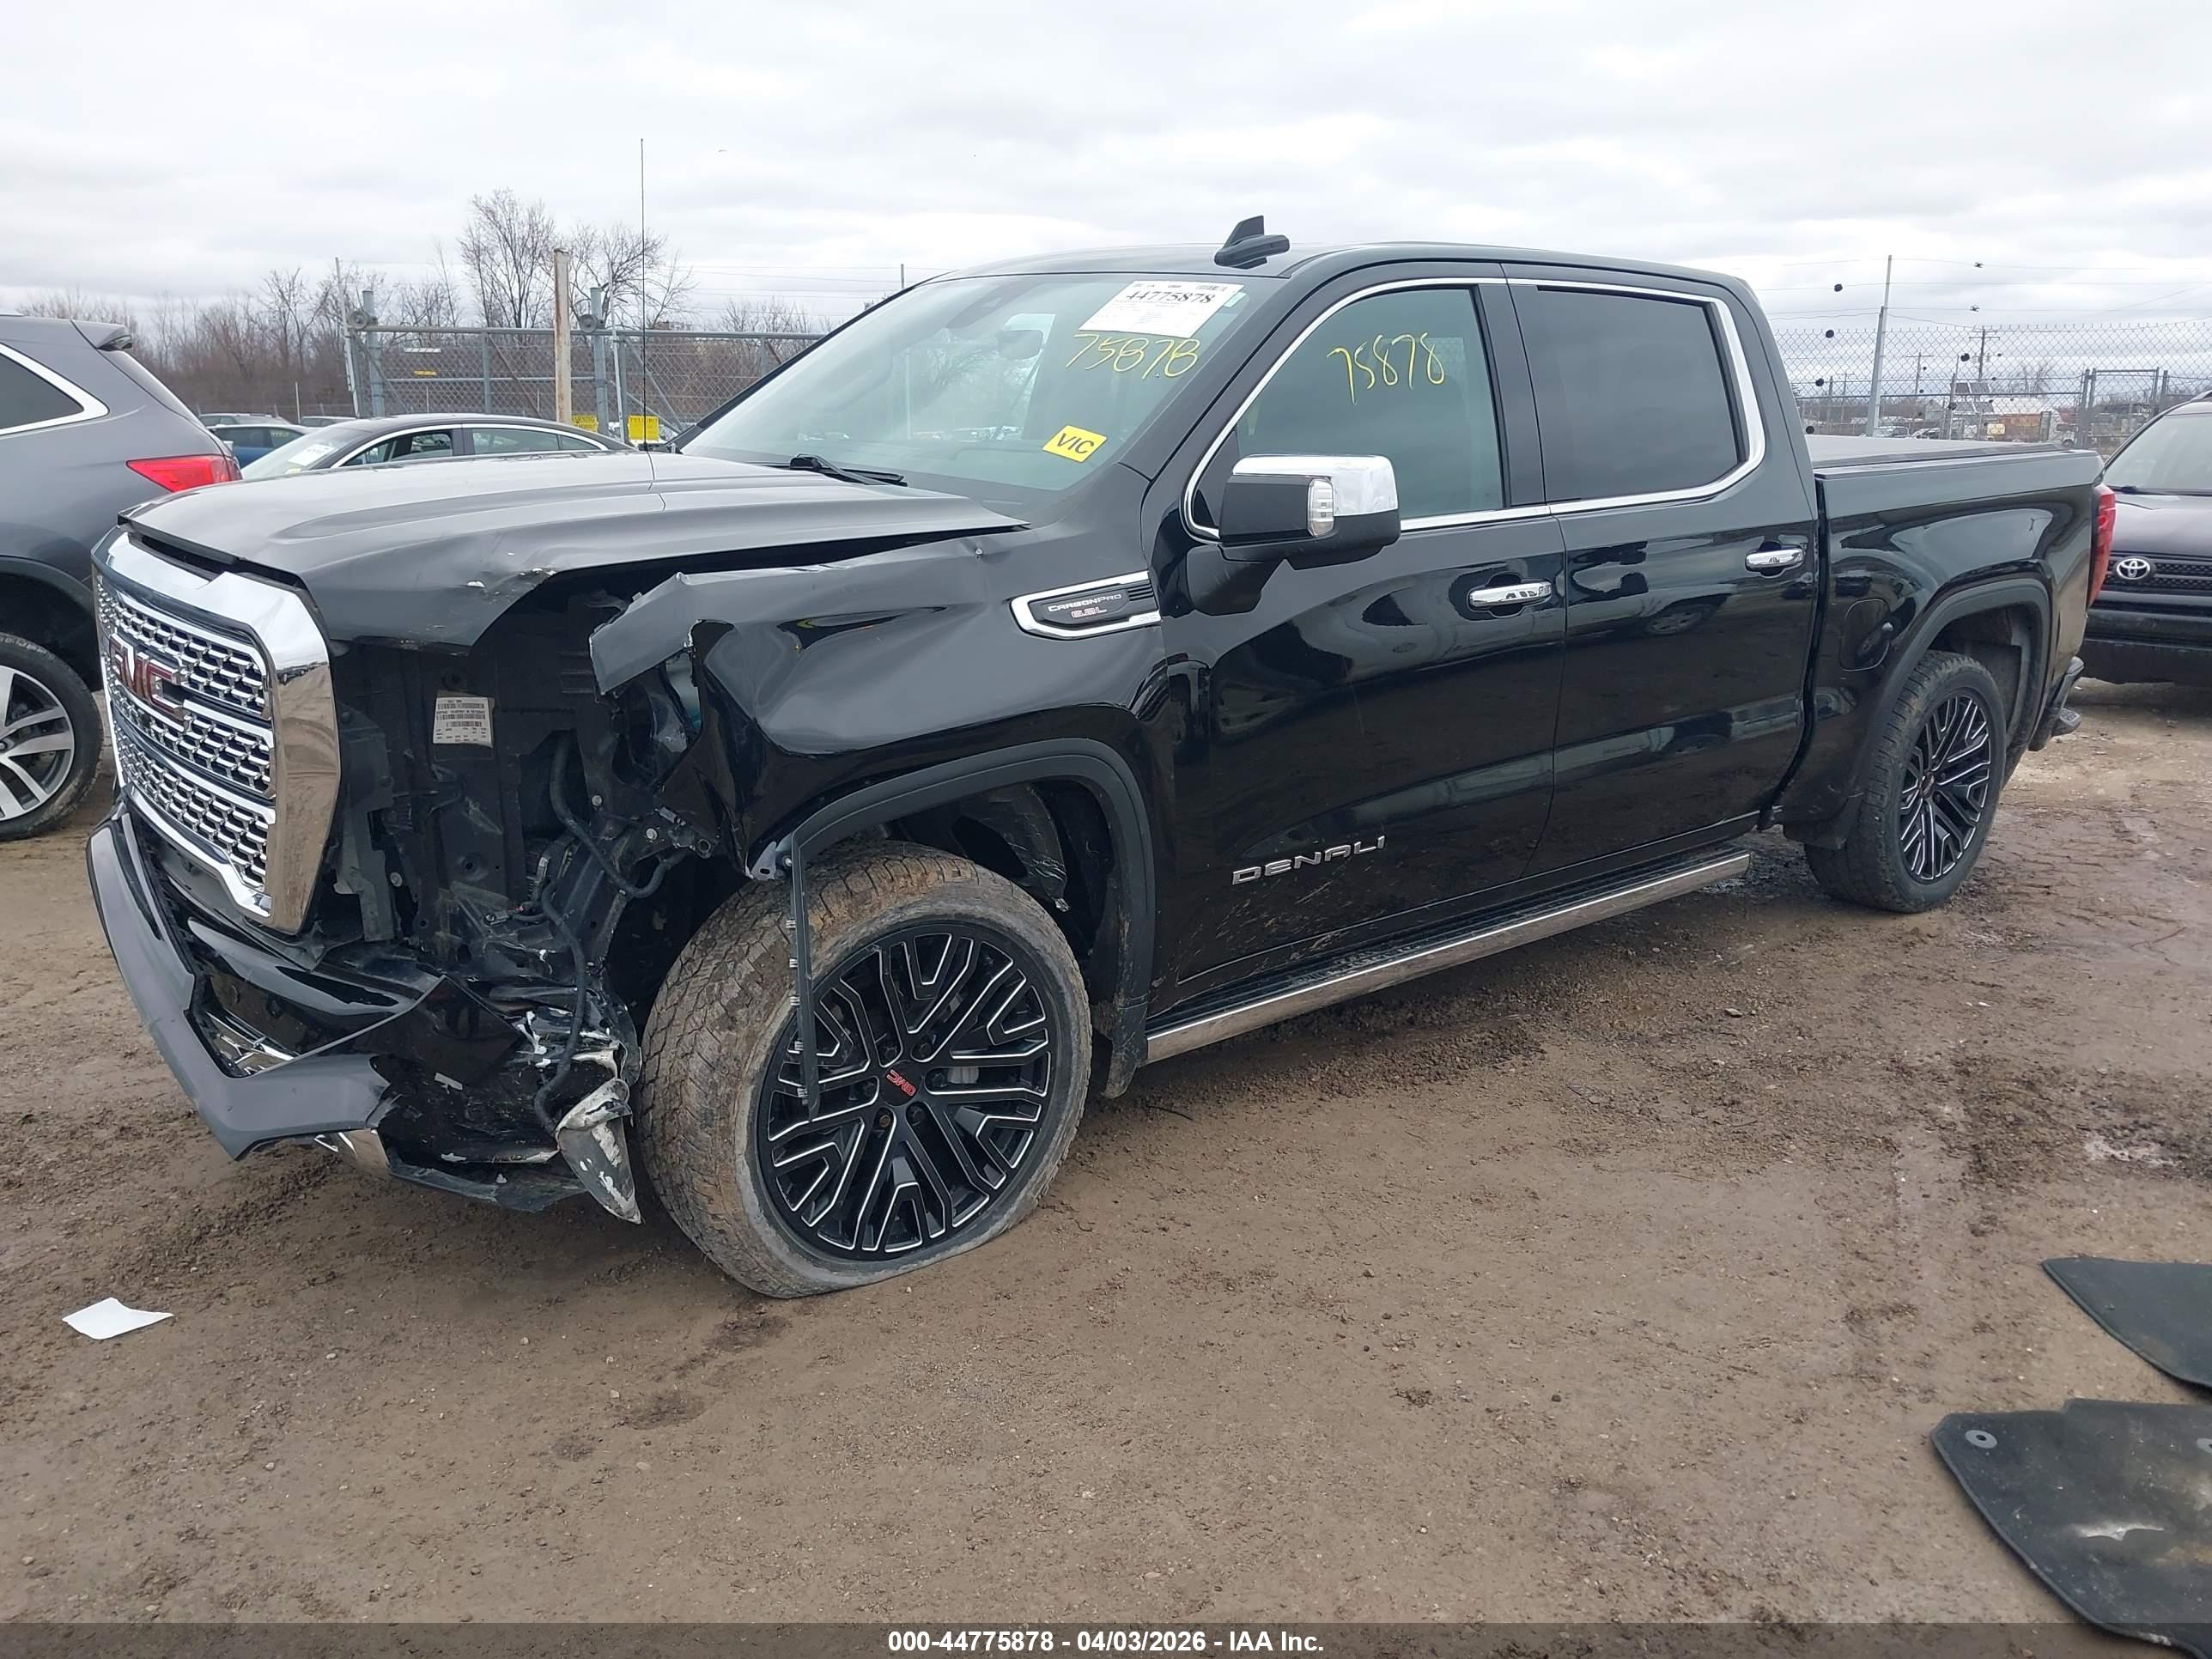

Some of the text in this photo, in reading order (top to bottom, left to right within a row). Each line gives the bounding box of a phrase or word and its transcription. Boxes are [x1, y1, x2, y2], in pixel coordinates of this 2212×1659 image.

[1126, 290, 1216, 304] 44775878
[1066, 333, 1201, 380] 75878
[1326, 331, 1445, 406] 75878
[1056, 432, 1095, 454] VIC
[109, 634, 188, 723] GMC
[1231, 835, 1386, 885] DENALI
[886, 1069, 916, 1097] GMC
